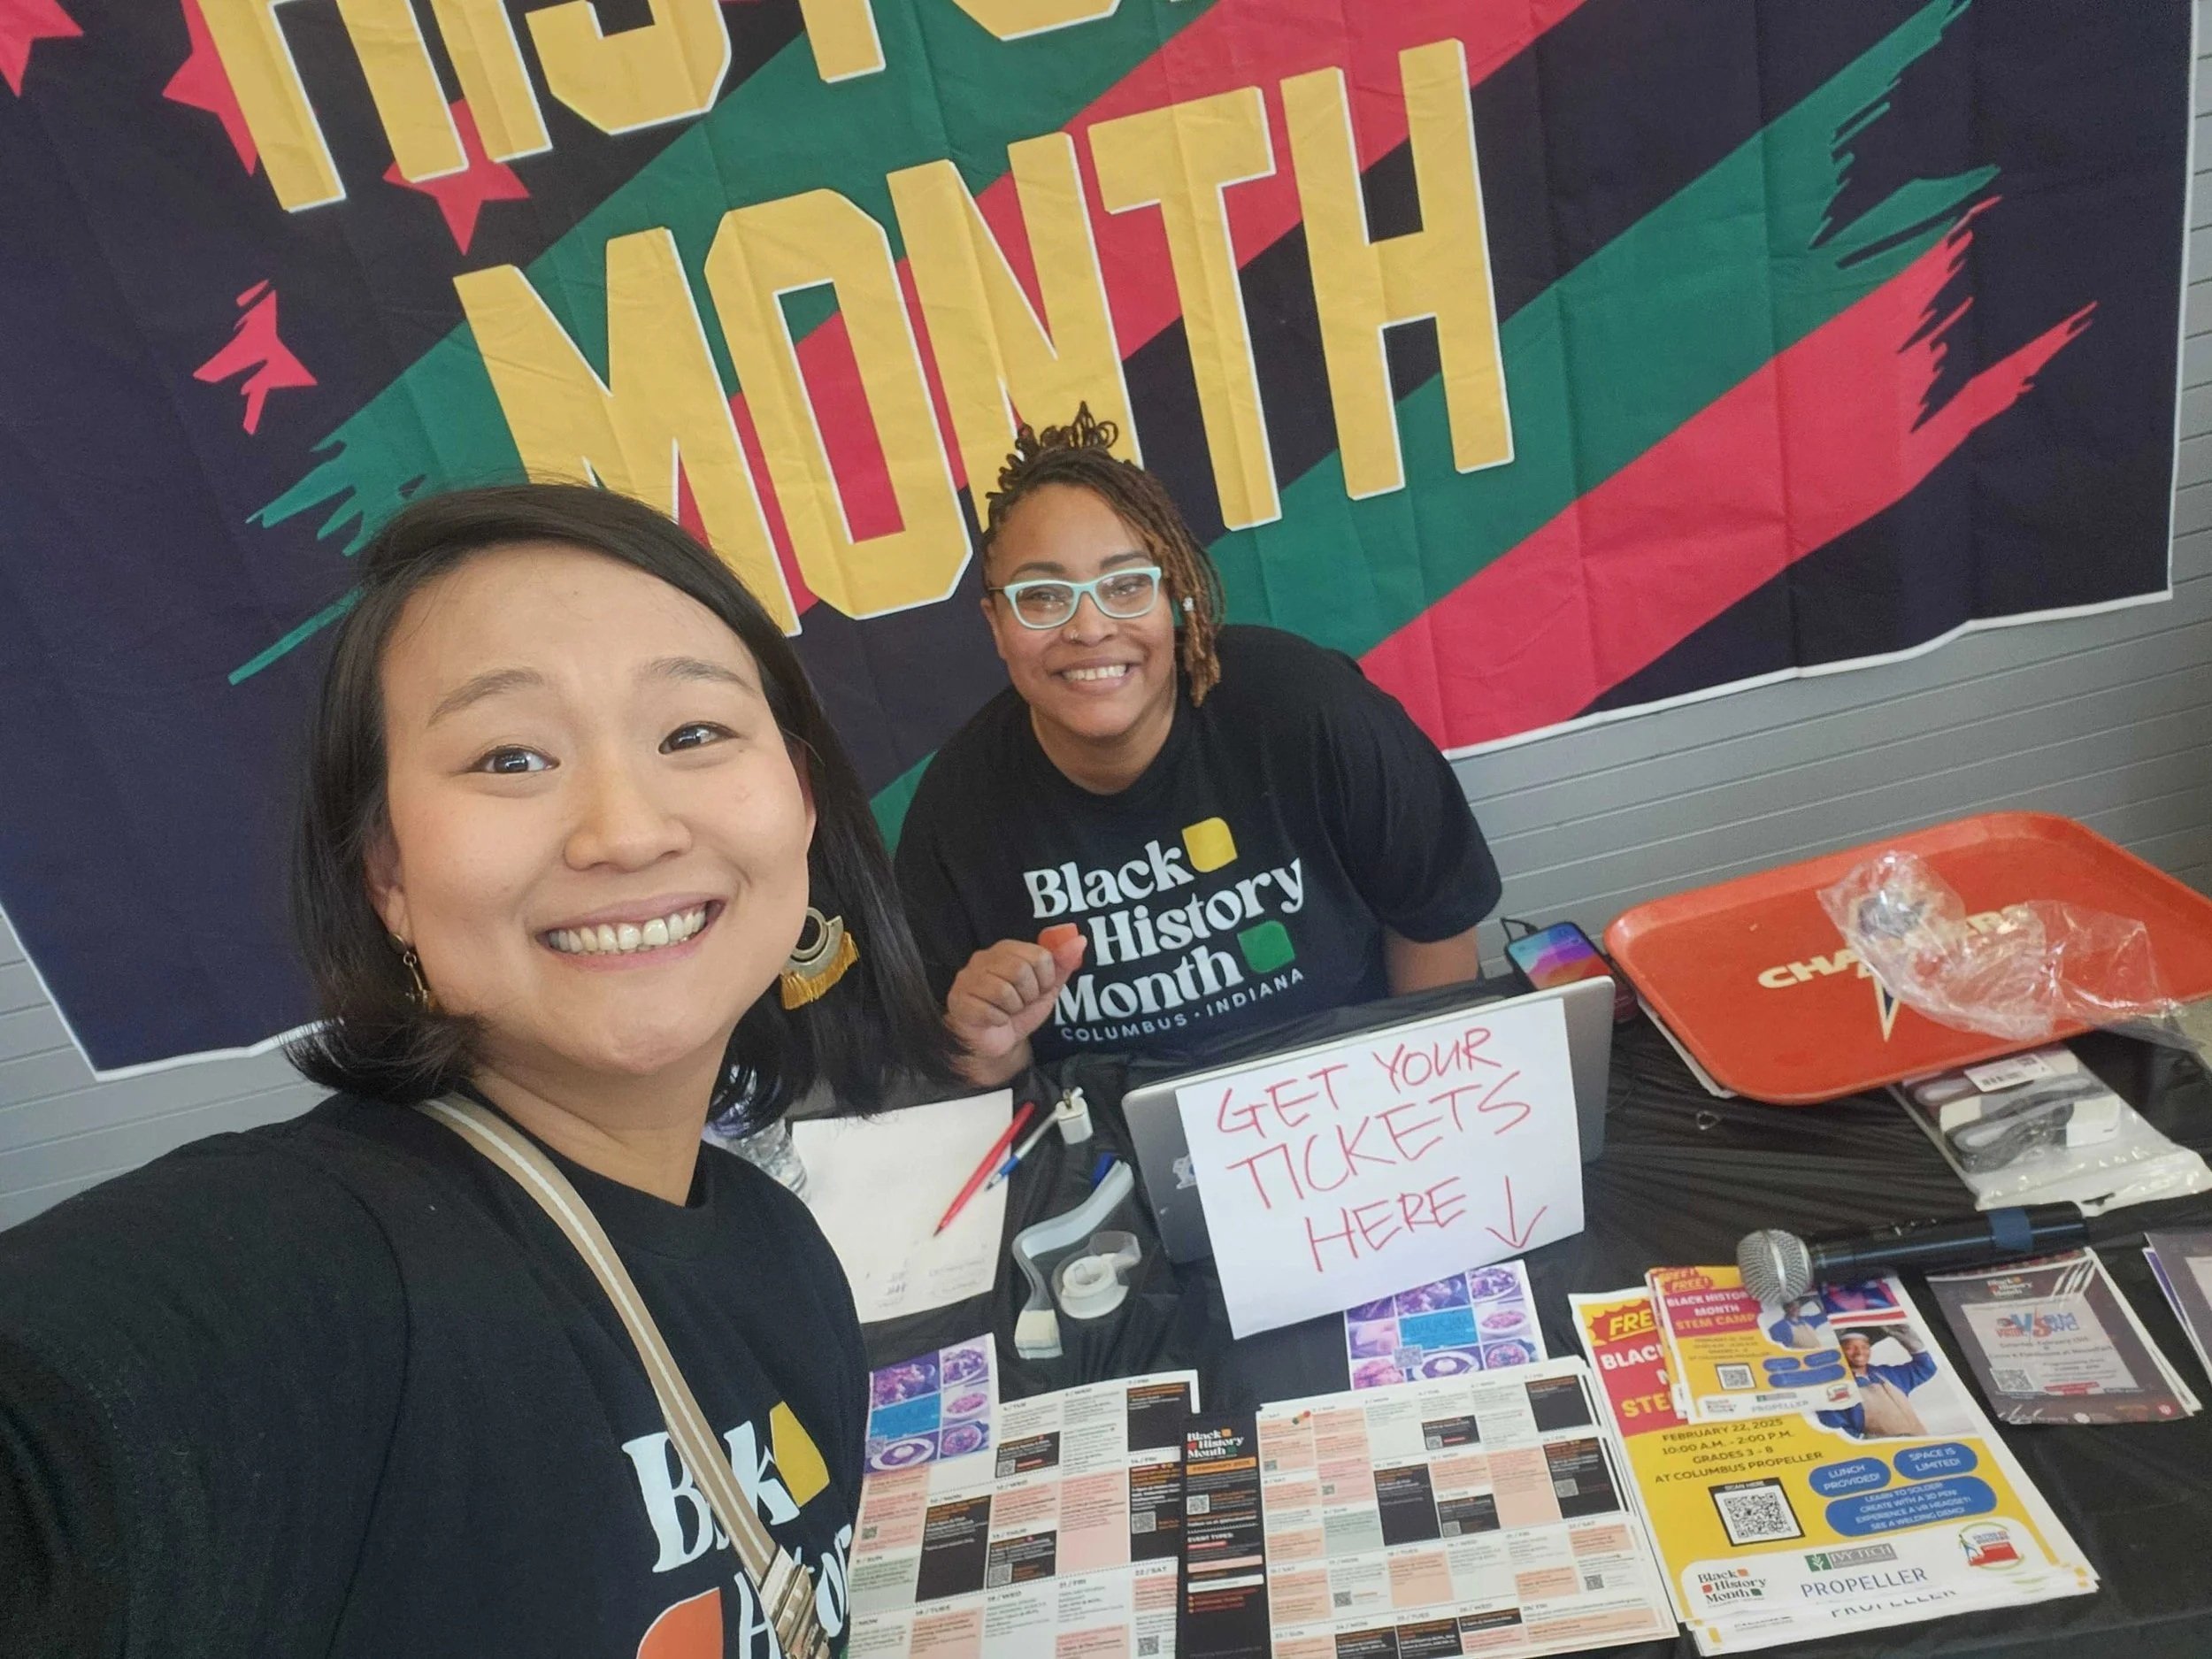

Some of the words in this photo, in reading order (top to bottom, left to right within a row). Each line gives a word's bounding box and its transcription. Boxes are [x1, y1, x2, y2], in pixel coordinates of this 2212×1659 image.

[452, 37, 1515, 636] MONTH
[1022, 840, 1194, 918] Black
[1087, 857, 1304, 966] History
[1054, 944, 1244, 1025] Month
[1062, 1012, 1188, 1041] COLUMBUS
[1205, 967, 1304, 1018] INDIANA
[1217, 1064, 1348, 1138] GET
[1373, 1027, 1502, 1094] YOUR
[1226, 1071, 1532, 1209] TICKETS
[1305, 1176, 1466, 1271] HERE
[1666, 1294, 1704, 1308] BLACK
[1706, 1290, 1749, 1302] HISTOR
[1694, 1303, 1740, 1317] MONTH
[1609, 1308, 1653, 1337] FRE
[1676, 1318, 1713, 1331] STEM
[1716, 1313, 1756, 1326] CAMP
[1621, 1392, 1671, 1417] STE
[1187, 1430, 1221, 1441] Black
[1663, 1426, 1727, 1441] FEBRUARY
[1753, 1418, 1784, 1430] 2025
[1198, 1436, 1245, 1449] History
[1663, 1443, 1697, 1455] 10:00
[1737, 1434, 1766, 1445] 2:00
[1187, 1447, 1227, 1458] Month
[1693, 1450, 1744, 1464] GRADES
[1909, 1448, 1942, 1462] SPACE
[1946, 1447, 1956, 1456] IS
[1655, 1473, 1671, 1484] AT
[1673, 1463, 1746, 1481] COLUMBUS
[1747, 1451, 1824, 1470] PROPELLER
[1828, 1463, 1865, 1479] LUNCH
[1823, 1472, 1880, 1491] PROVIDED!
[1860, 1502, 1893, 1514] CREATE
[1895, 1498, 1916, 1509] WITH
[1864, 1492, 1893, 1502] LEARN
[1855, 1509, 1909, 1525] EXPERIENCE
[1870, 1521, 1887, 1531] SEE
[1896, 1512, 1937, 1525] WELDING
[1831, 1551, 1855, 1563] IVY
[1857, 1545, 1893, 1558] TECH
[1697, 1567, 1739, 1583] Black
[1800, 1567, 1928, 1598] PROPELLER
[1715, 1578, 1767, 1592] History
[1705, 1587, 1751, 1603] Month
